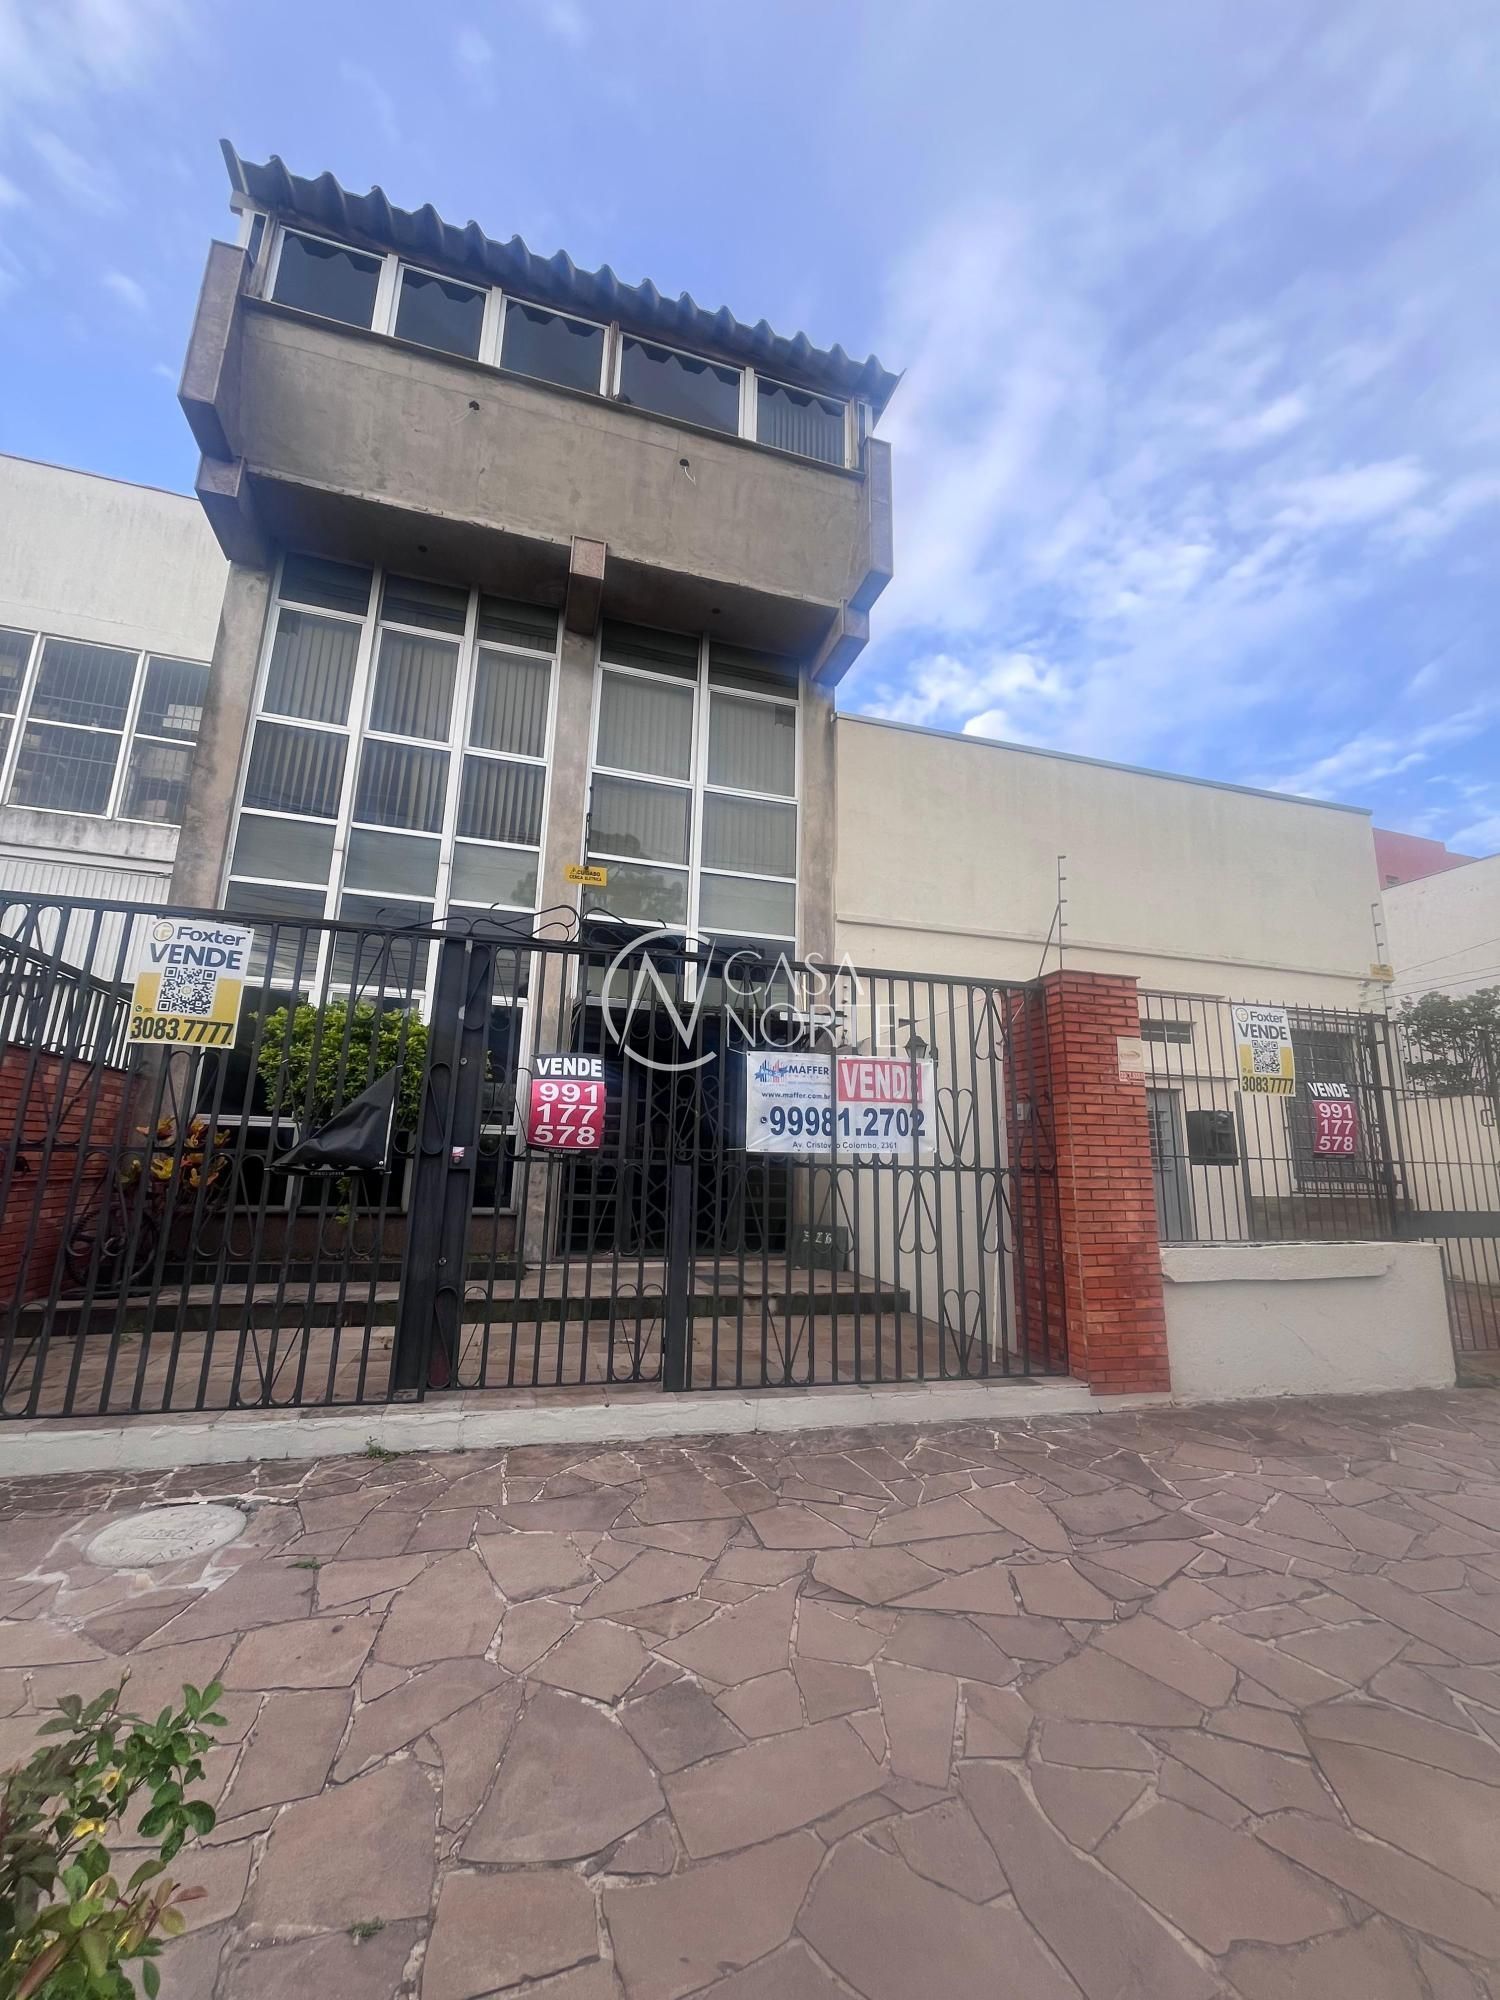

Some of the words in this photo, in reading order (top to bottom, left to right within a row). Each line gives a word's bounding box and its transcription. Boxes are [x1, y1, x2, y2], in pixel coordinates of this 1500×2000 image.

[177, 926, 246, 947] Foxter
[150, 943, 243, 970] VENDE
[1250, 1011, 1284, 1023] Foxter
[130, 1016, 234, 1044] 3083.7777
[1238, 1023, 1288, 1040] VENDE
[536, 1057, 602, 1078] VENDE
[788, 1065, 829, 1075] MAFFER
[539, 1083, 598, 1104] 991
[762, 1091, 831, 1100] www.maffer.com.br
[1307, 1082, 1351, 1098] VENDE
[536, 1103, 598, 1124] 177
[1319, 1103, 1353, 1119] 991
[533, 1125, 596, 1145] 578
[1321, 1119, 1353, 1135] 177
[1319, 1136, 1353, 1151] 578
